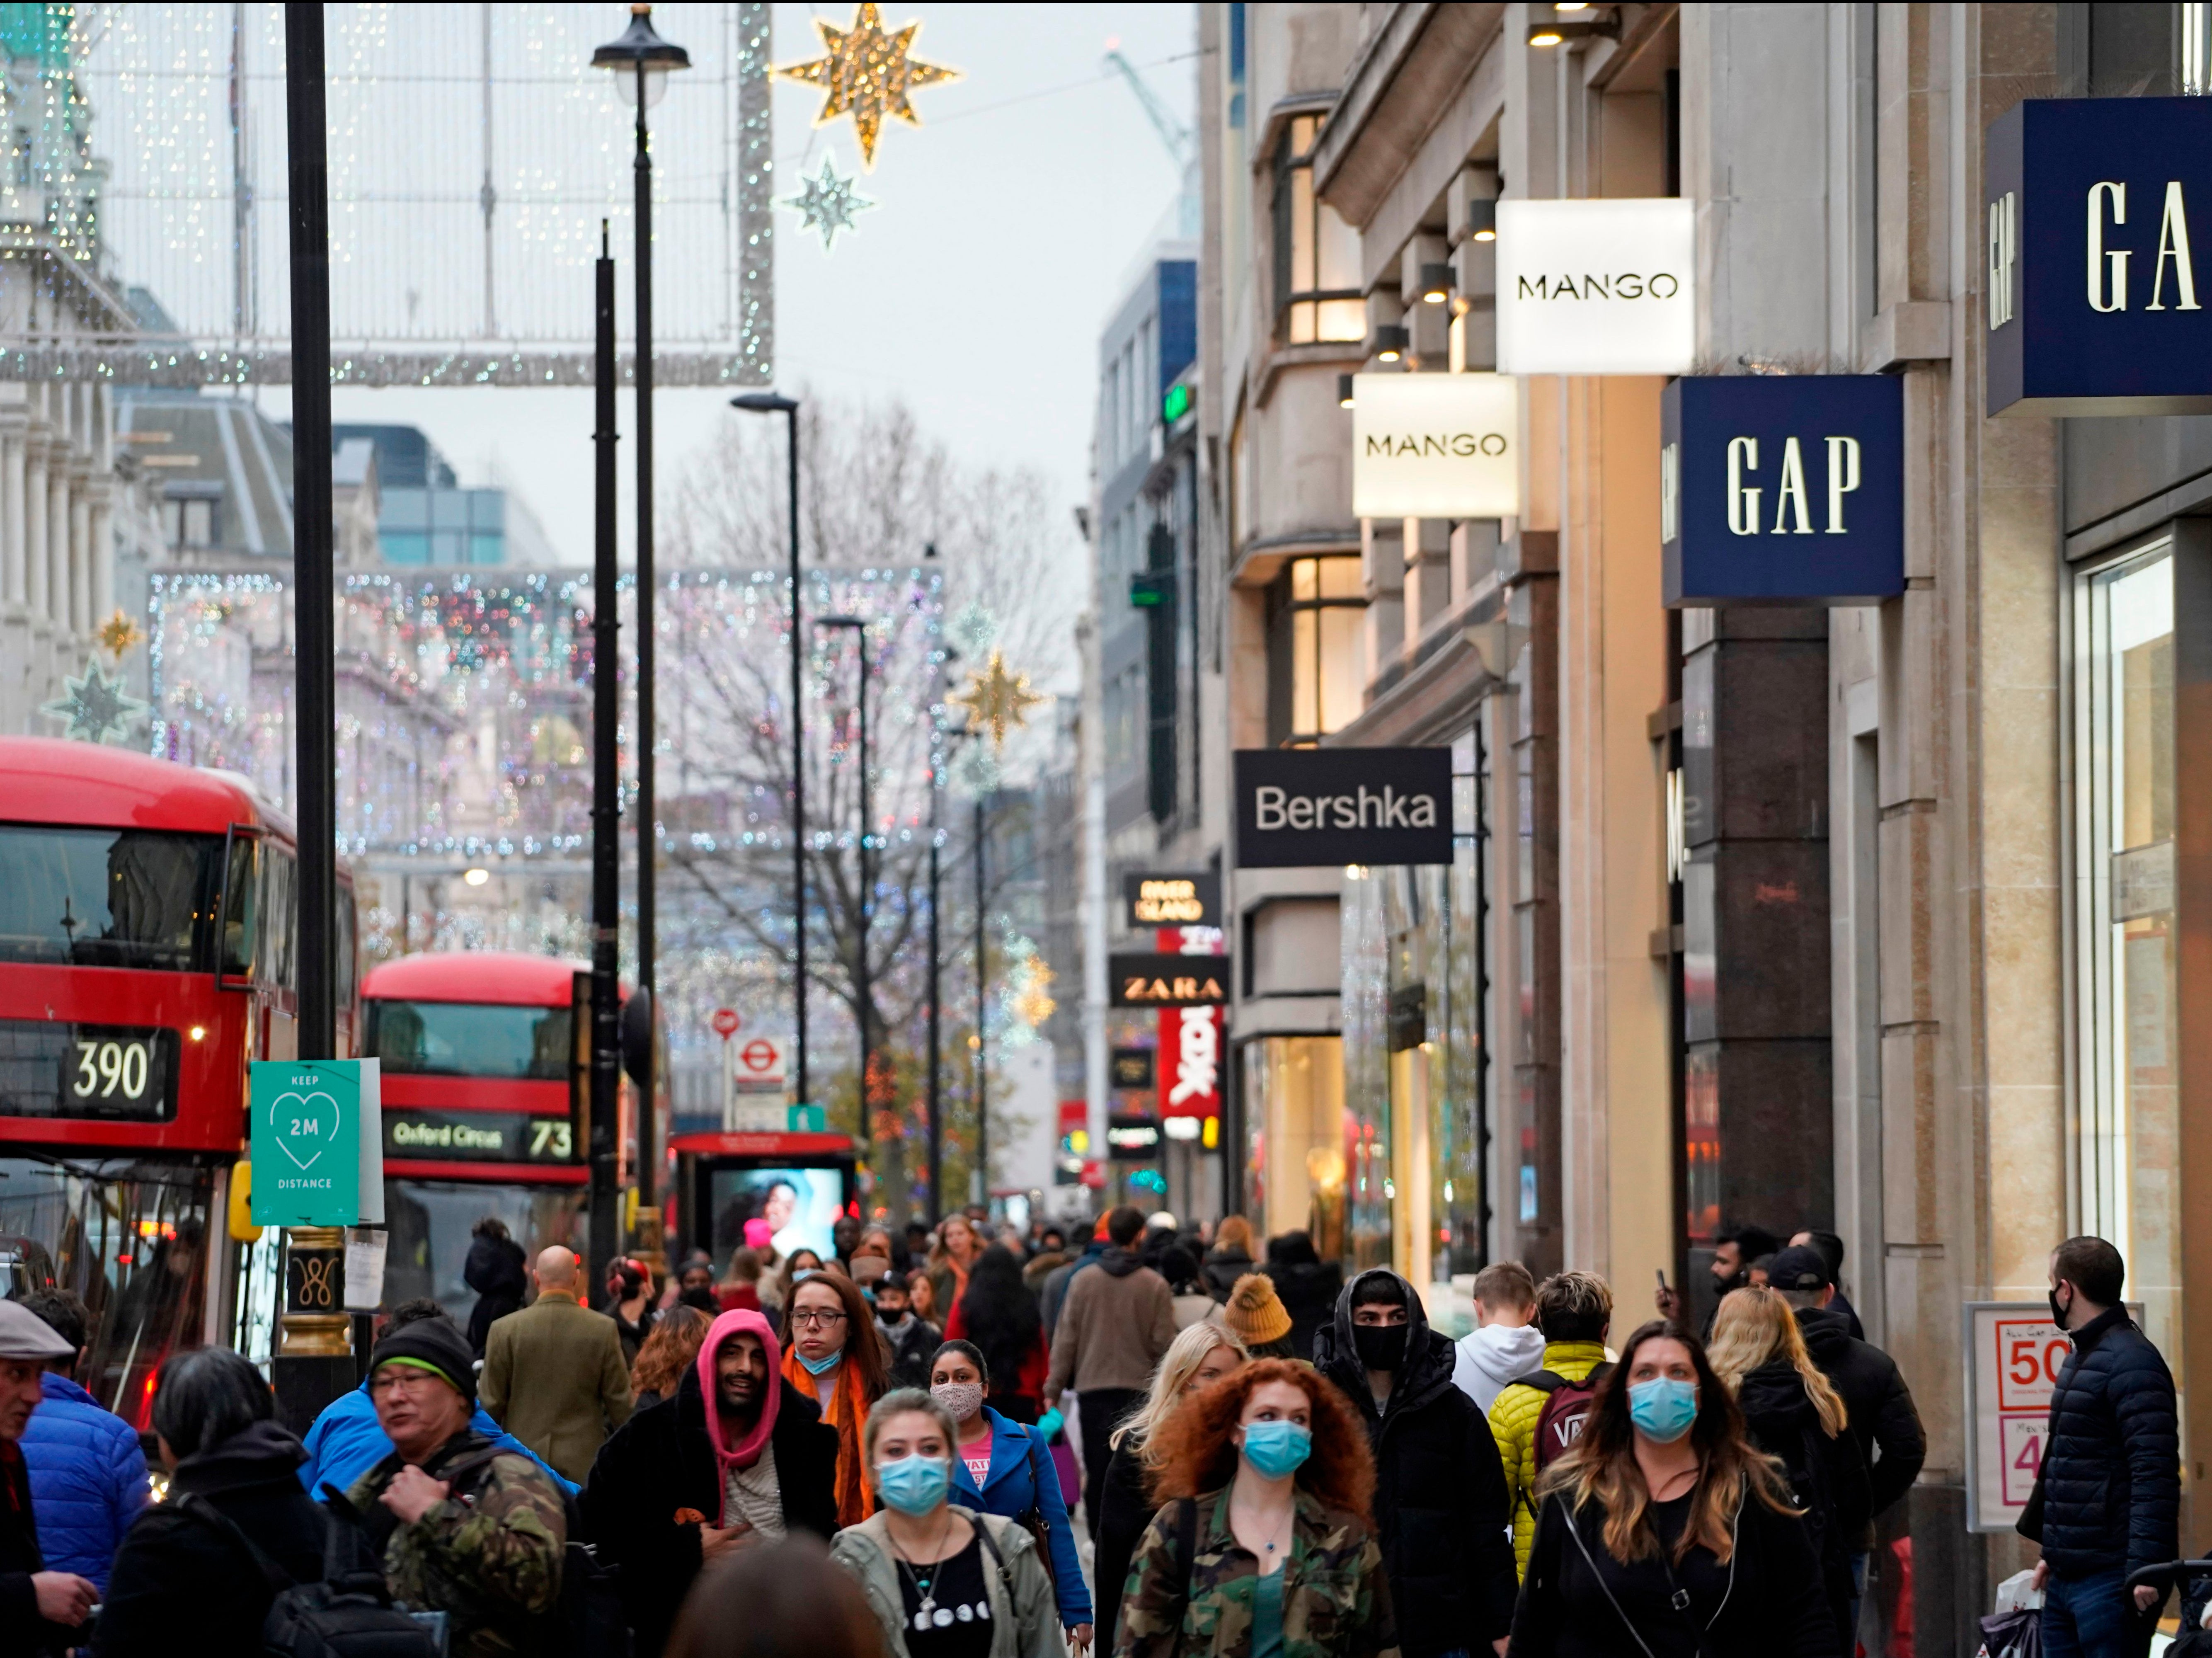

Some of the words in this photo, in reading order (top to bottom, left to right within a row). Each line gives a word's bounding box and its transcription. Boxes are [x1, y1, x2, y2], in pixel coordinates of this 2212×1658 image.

[2087, 181, 2202, 313] GA
[1519, 274, 1677, 300] MANGO
[1366, 433, 1507, 457] MANGO
[1727, 437, 1861, 535] GAP
[1255, 784, 1437, 830] Bershka
[1124, 977, 1223, 999] ZARA
[74, 1042, 147, 1100] 390
[292, 1076, 319, 1085] KEEP
[291, 1118, 318, 1135] 2M
[393, 1122, 451, 1147] Oxford
[453, 1125, 503, 1149] Circus
[530, 1121, 572, 1159] 73
[279, 1179, 331, 1189] DISTANCE
